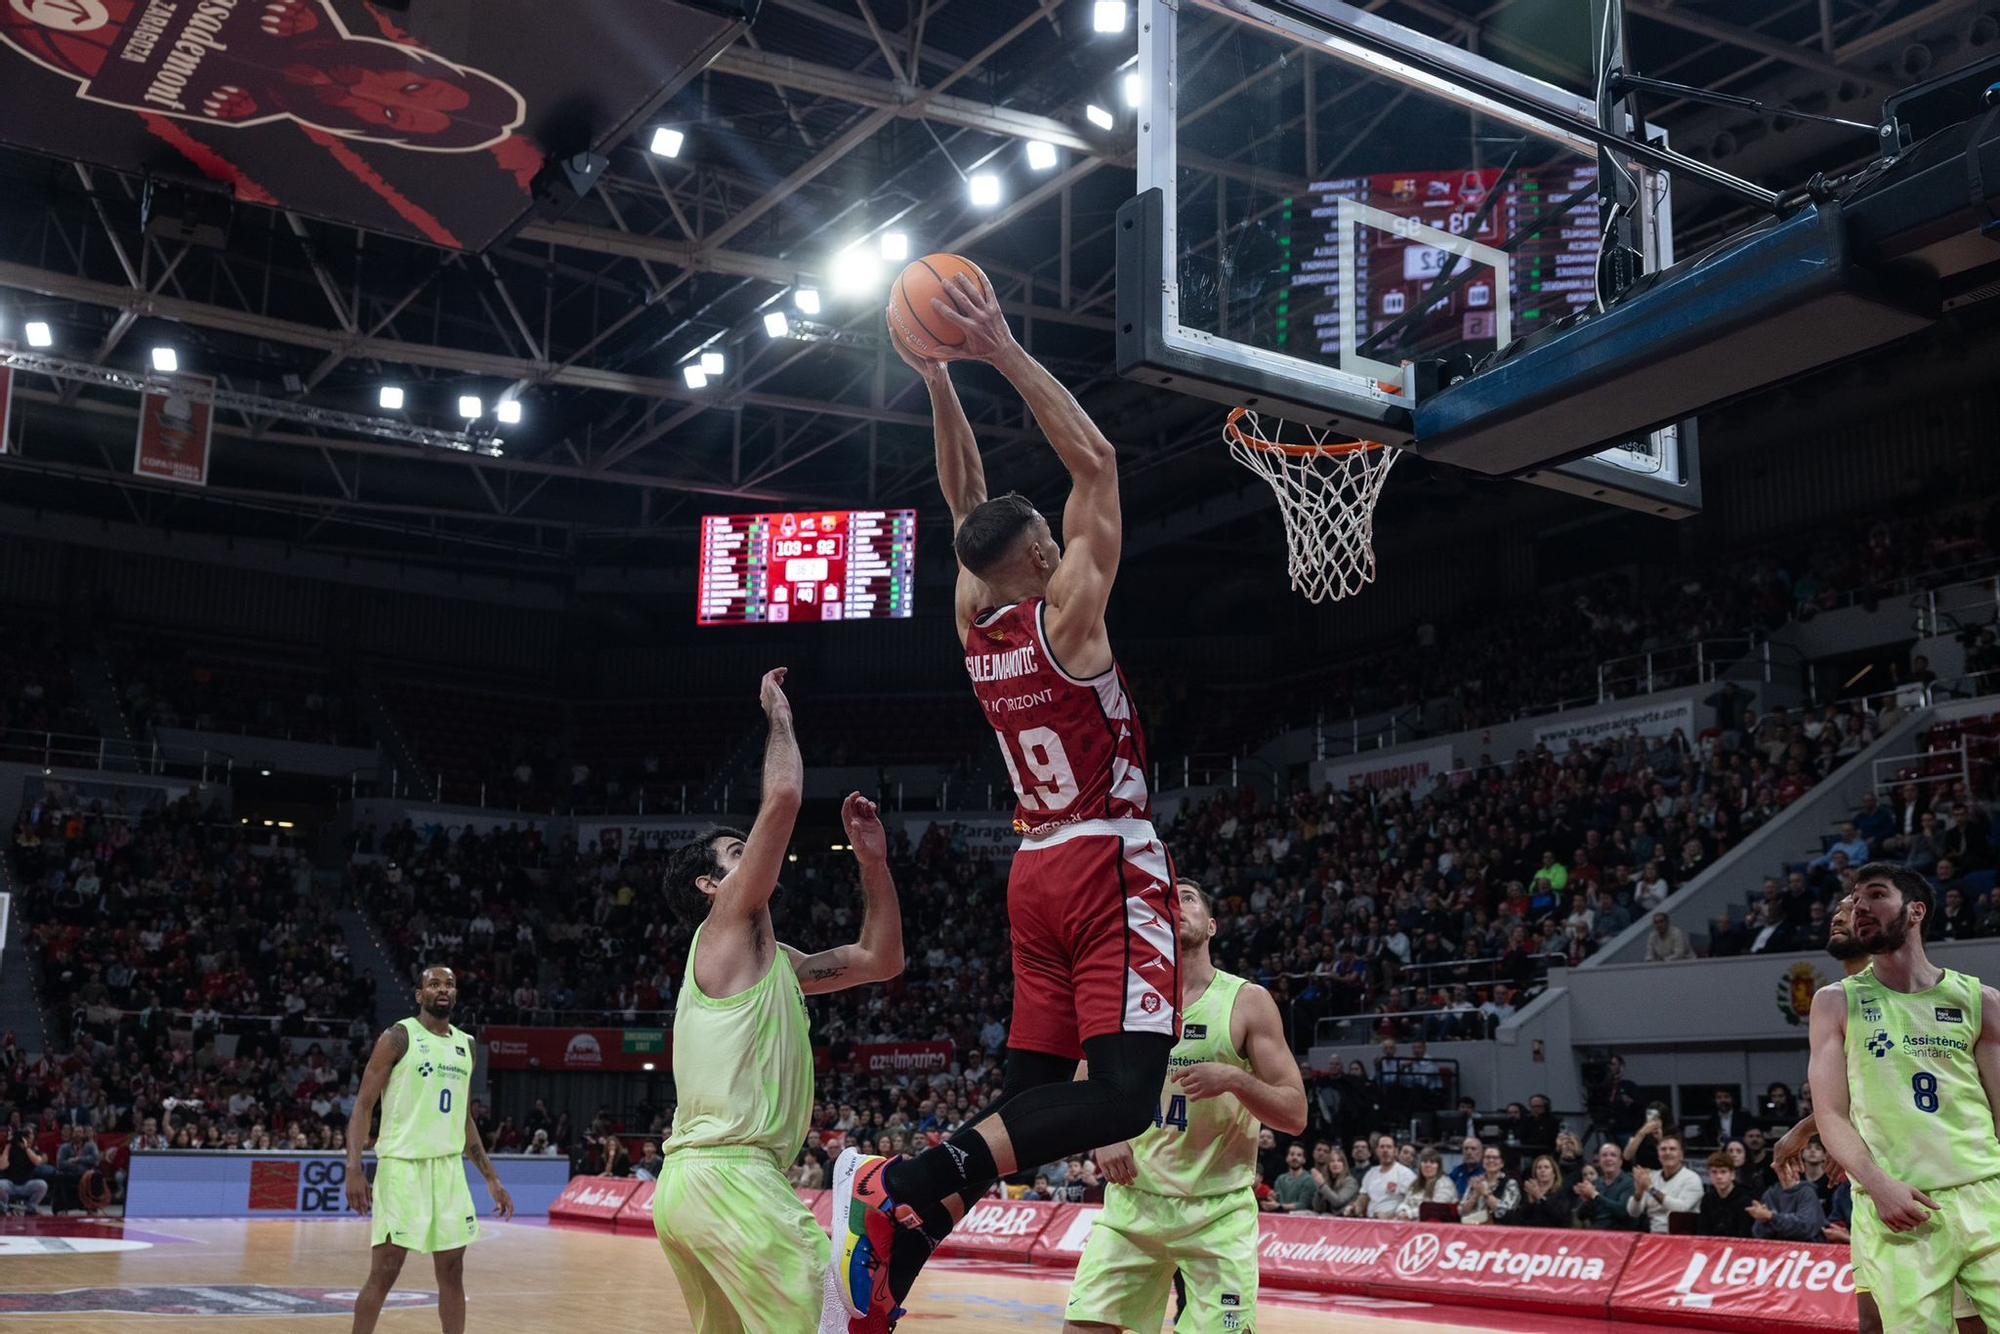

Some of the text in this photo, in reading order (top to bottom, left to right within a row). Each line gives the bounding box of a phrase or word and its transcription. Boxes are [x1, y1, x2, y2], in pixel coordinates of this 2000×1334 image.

[144, 0, 238, 110] asademont
[996, 726, 1080, 811] 19
[1902, 1035, 1969, 1051] Assistència
[1903, 1045, 1953, 1060] Sanitària
[439, 1088, 452, 1114] 0
[1911, 1072, 1939, 1113] 8
[302, 1187, 340, 1212] DE
[1438, 1241, 1605, 1282] Sartopina
[1710, 1247, 1857, 1293] levitec
